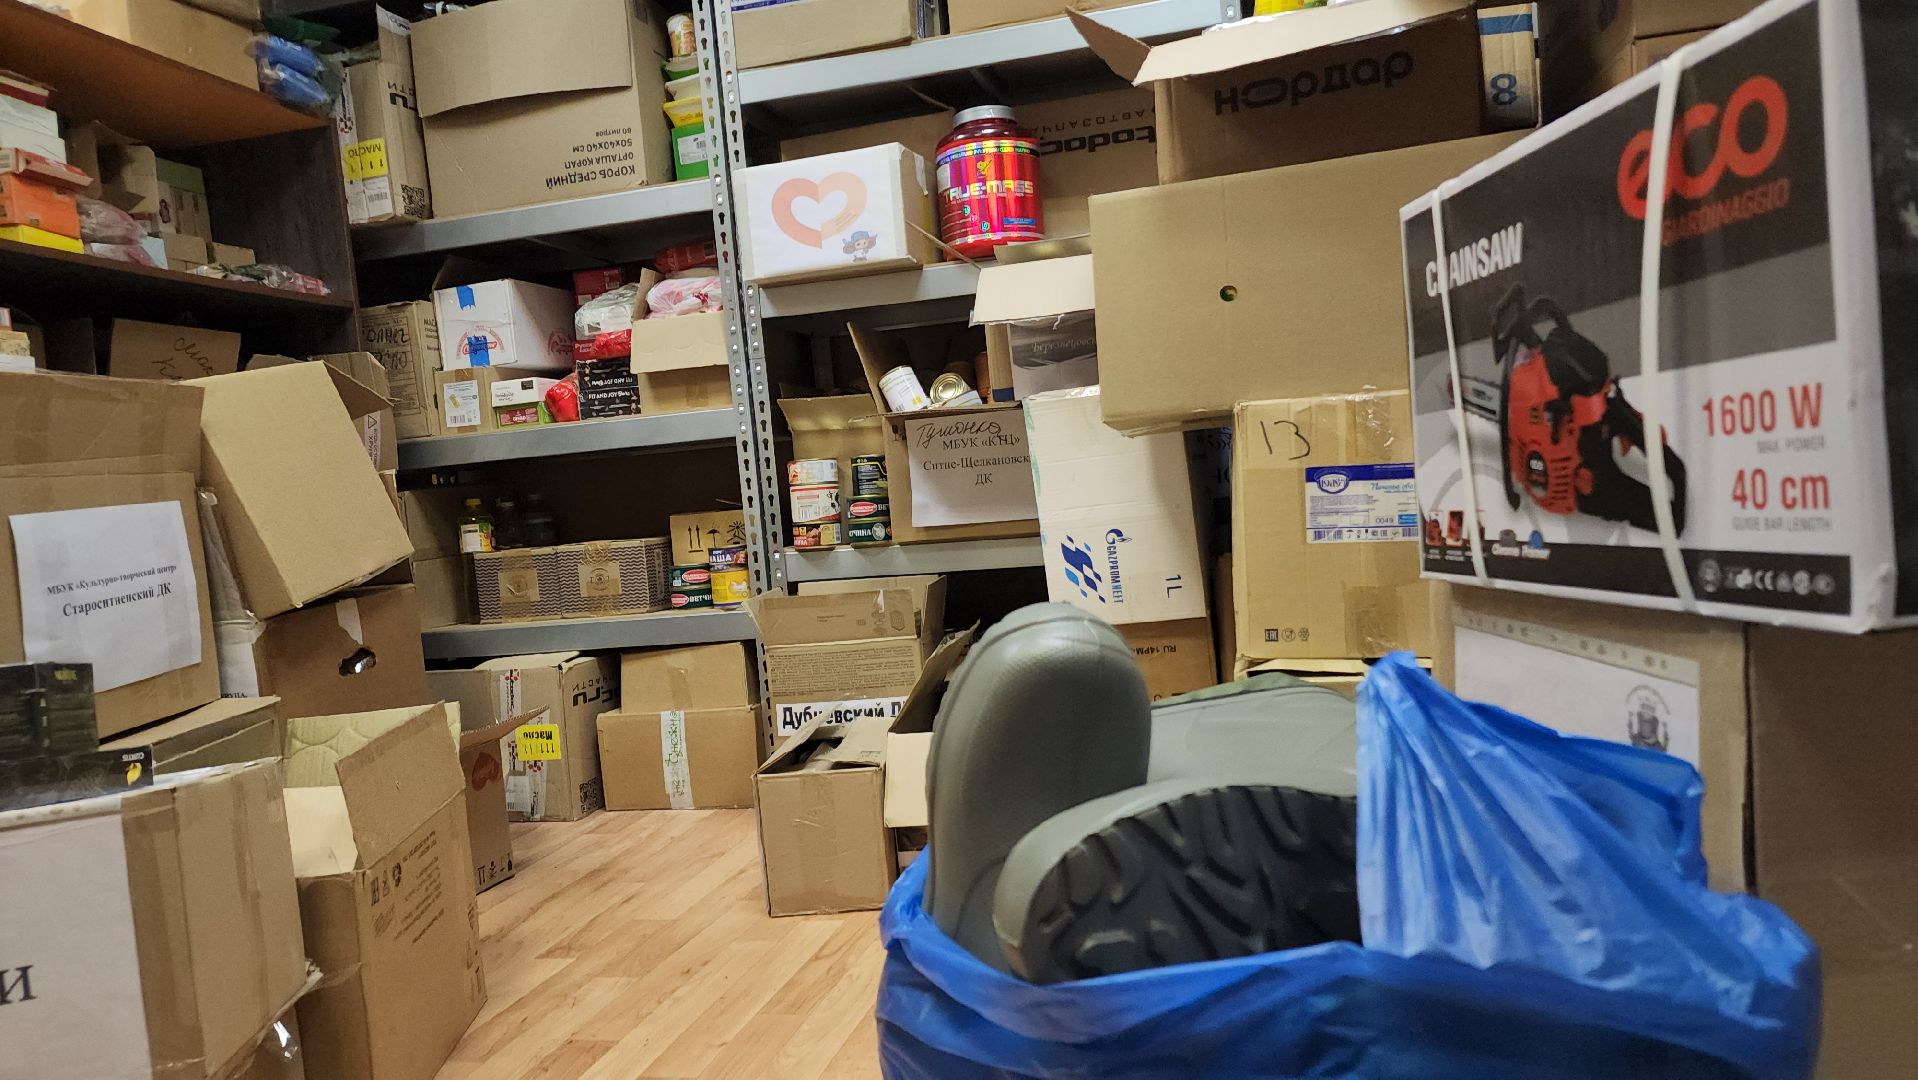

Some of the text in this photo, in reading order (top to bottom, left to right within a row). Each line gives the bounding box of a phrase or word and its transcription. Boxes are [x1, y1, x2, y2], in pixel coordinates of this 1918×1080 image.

[1491, 74, 1518, 106] 8
[595, 151, 634, 164] ОРТАША
[1617, 75, 1788, 220] eco
[545, 164, 636, 189] КОРОБ СРЕДНИЙ
[944, 179, 1034, 204] TRUE-MASS
[1425, 222, 1523, 298] CAINSAW
[1702, 382, 1823, 437] 1600 W
[942, 439, 979, 451] МБУК
[1260, 420, 1311, 460] 13
[975, 472, 993, 486] ДК
[1731, 468, 1831, 510] 40 cm
[1165, 574, 1182, 582] 1
[46, 582, 74, 596] МБУК
[156, 582, 172, 598] ДК
[1167, 585, 1183, 598] L
[522, 730, 553, 740] Масло
